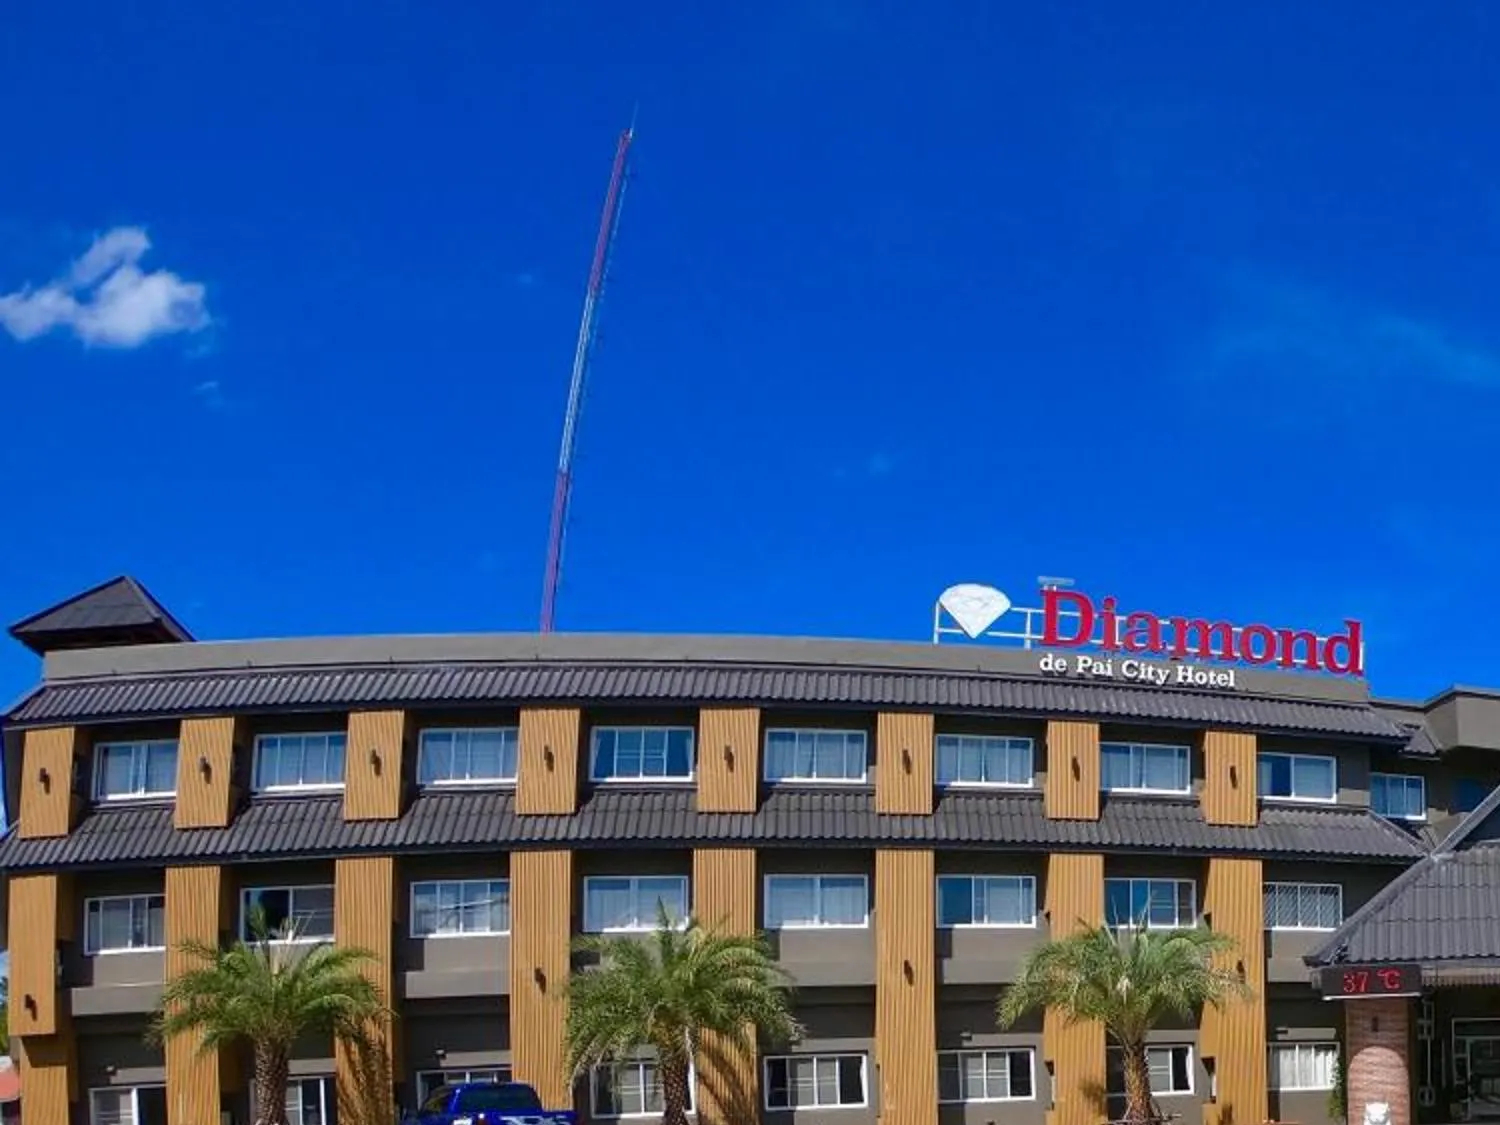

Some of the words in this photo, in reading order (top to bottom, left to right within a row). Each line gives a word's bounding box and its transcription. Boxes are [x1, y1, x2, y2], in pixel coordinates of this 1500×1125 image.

[1039, 588, 1364, 676] Diamond
[1038, 654, 1068, 672] de
[1076, 655, 1114, 676] Pai
[1121, 659, 1171, 685] City
[1176, 664, 1236, 687] Hotel
[1343, 970, 1369, 993] 37
